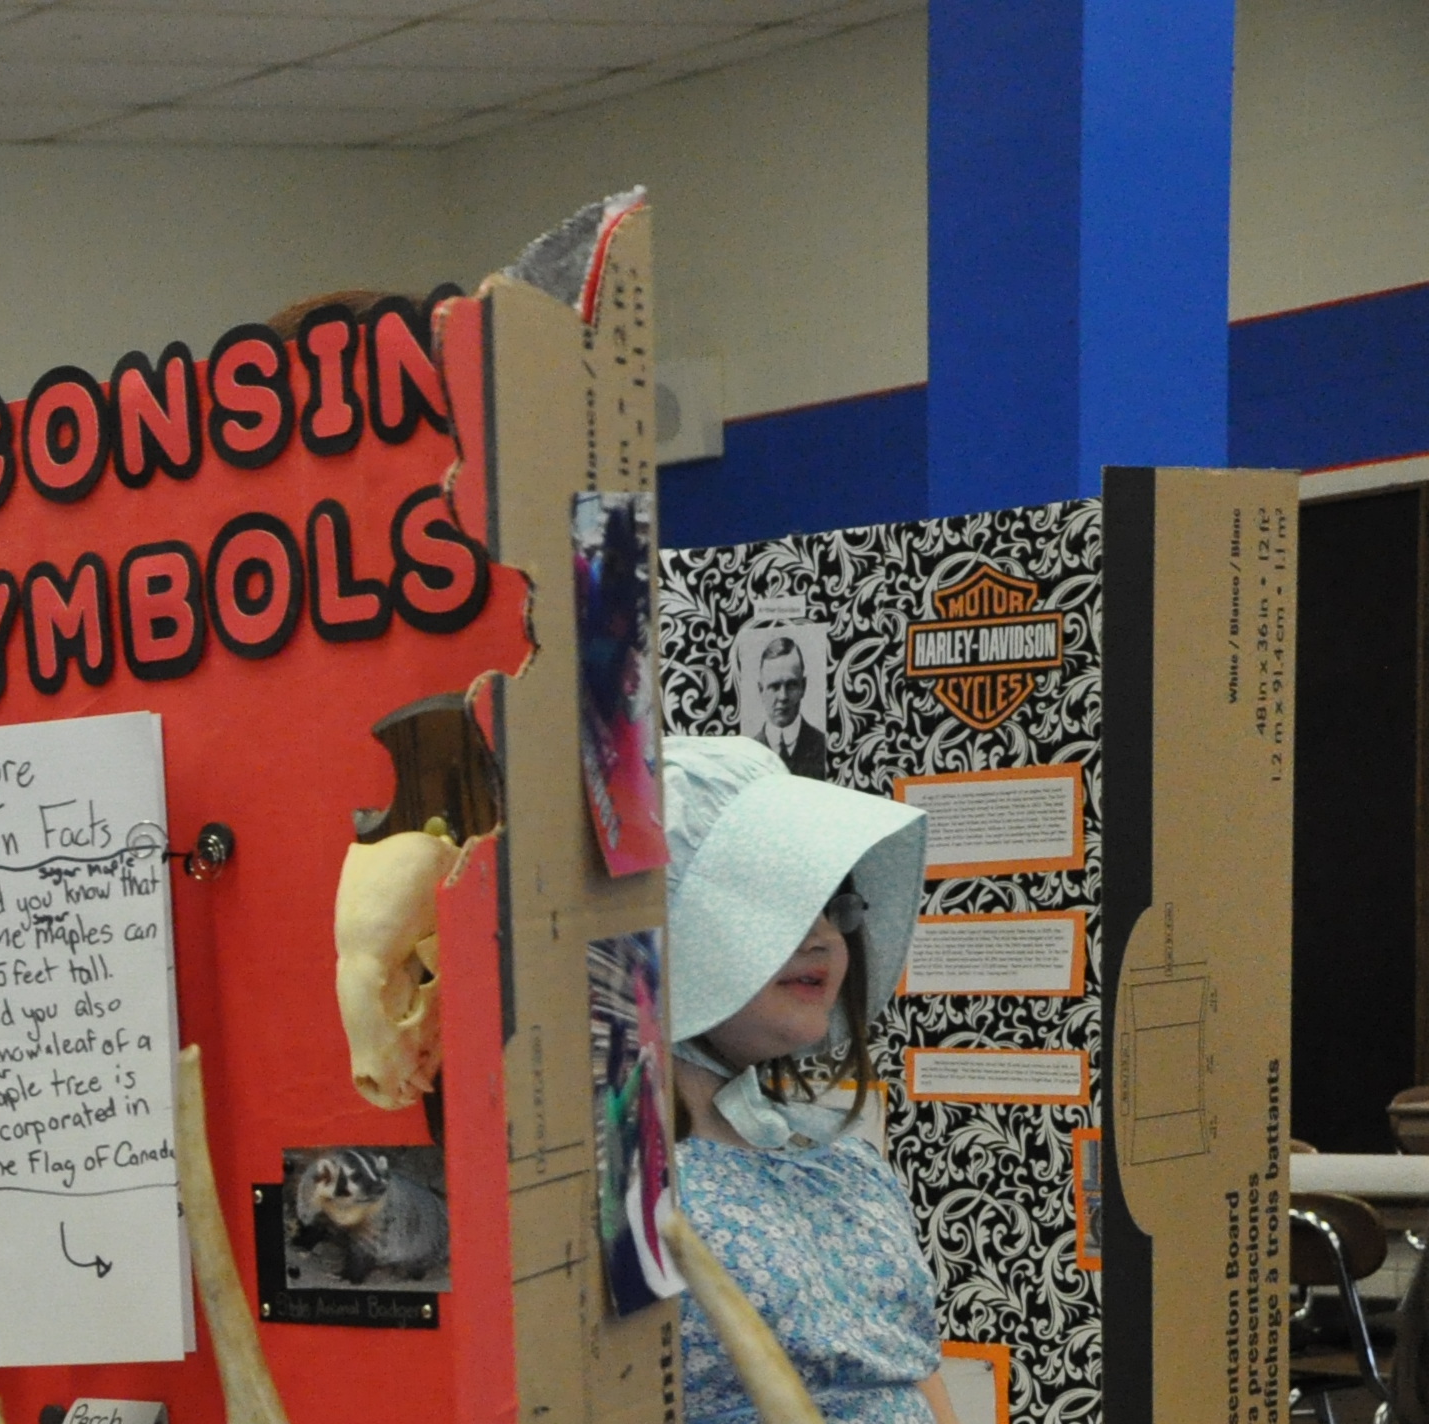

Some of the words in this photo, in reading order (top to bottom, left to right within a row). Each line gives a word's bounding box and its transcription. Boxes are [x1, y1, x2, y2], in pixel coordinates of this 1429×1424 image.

[1229, 507, 1241, 558] Blanc
[948, 579, 1024, 618] MOTOR
[1228, 575, 1240, 636] Blanco
[1256, 598, 1268, 618] in
[914, 622, 1057, 667] HARLEY-DAVIDSON
[1256, 622, 1268, 652] 36
[1275, 606, 1286, 643] cm
[1228, 654, 1240, 705] White
[1273, 648, 1284, 693] 91.4
[947, 673, 1023, 720] CYCLES
[1254, 682, 1267, 703] in
[1254, 707, 1267, 736] 48
[1271, 753, 1283, 782] 1.2
[39, 799, 113, 849] Facts
[15, 891, 53, 932] you
[63, 878, 111, 904] know
[120, 865, 161, 897] that
[35, 914, 114, 955] maples
[124, 922, 158, 942] can
[13, 956, 60, 986] feet
[21, 1002, 58, 1042] you
[74, 991, 122, 1019] also
[52, 1029, 97, 1056] leaf
[137, 1034, 152, 1051] a
[50, 1069, 103, 1097] tree
[115, 1064, 137, 1090] is
[125, 1095, 150, 1116] in
[1262, 1058, 1282, 1180] battants
[28, 1149, 76, 1189] Flag
[1223, 1191, 1240, 1280] Board
[1264, 1190, 1281, 1257] trois
[1244, 1171, 1262, 1397] presentaciones
